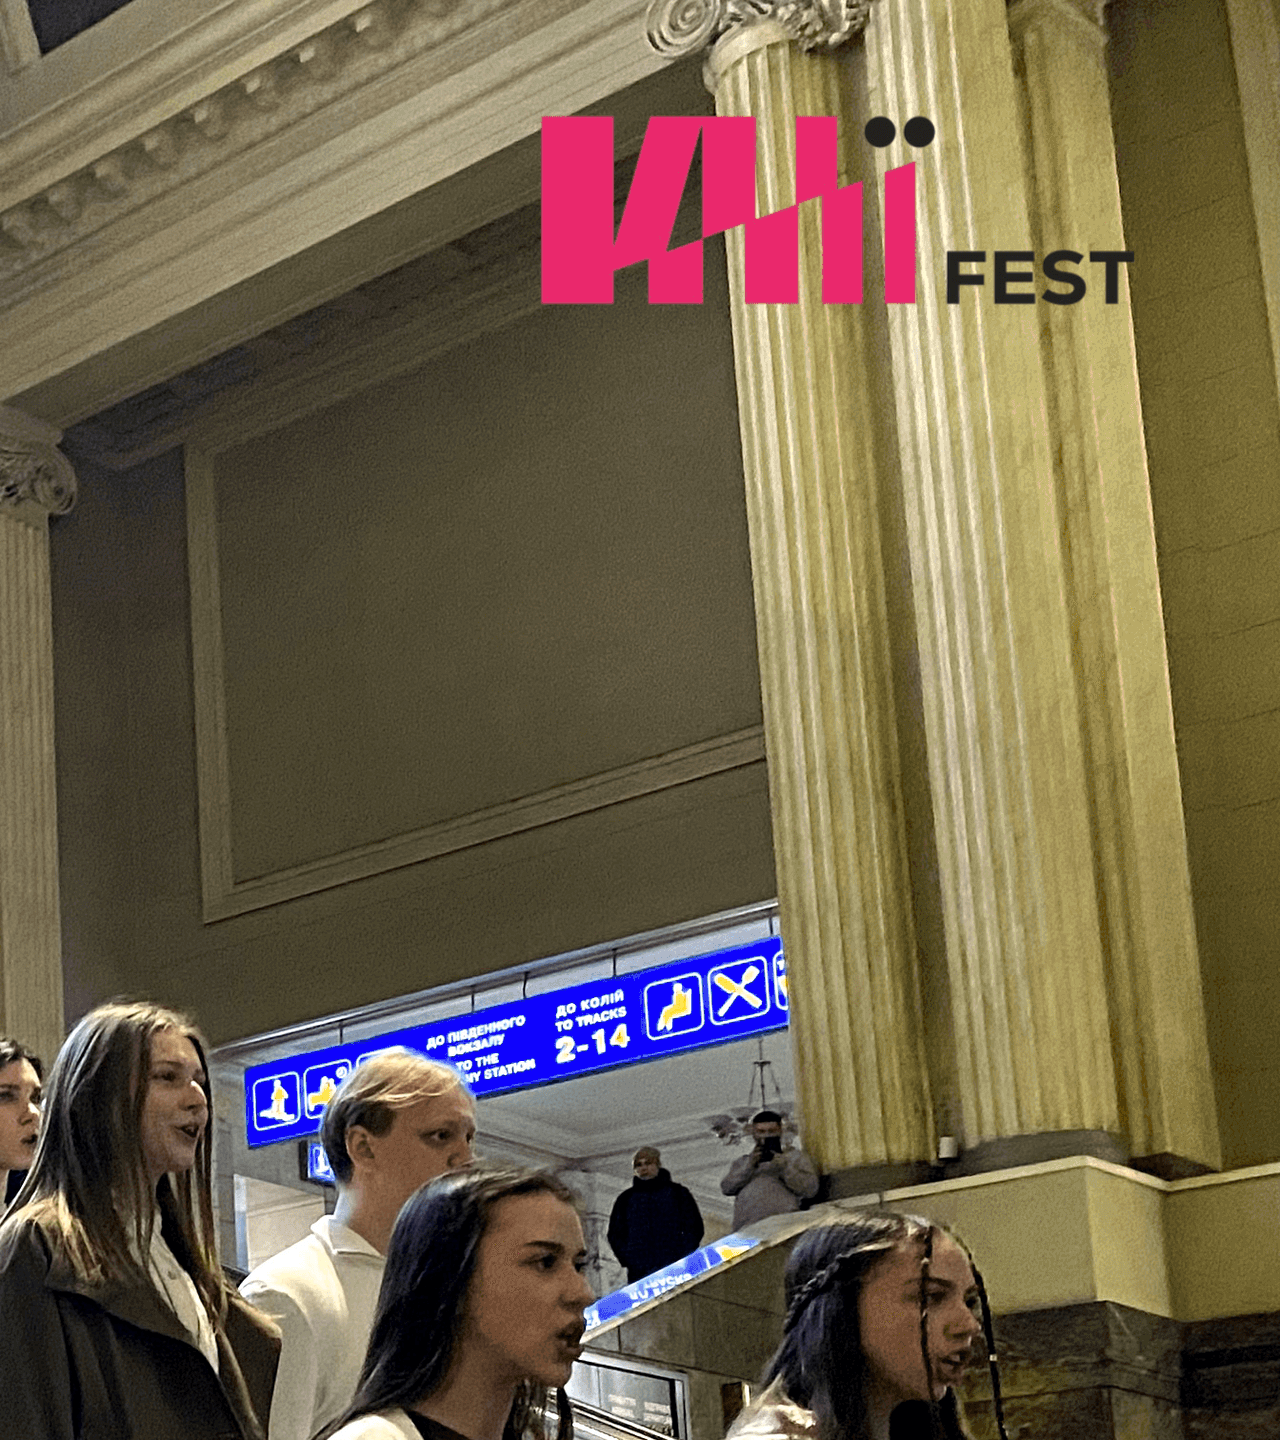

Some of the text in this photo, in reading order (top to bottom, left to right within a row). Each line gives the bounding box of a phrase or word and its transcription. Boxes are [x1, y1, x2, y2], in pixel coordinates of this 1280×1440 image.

[556, 988, 625, 1019] ДО КОЛІЙ
[555, 1006, 627, 1032] TO TRACKS
[426, 1015, 526, 1050] ДО ПІВДЕННОГО
[448, 1033, 505, 1057] ВОКЗАЛУ
[555, 1023, 631, 1064] 2-14
[475, 1053, 500, 1068] THE
[484, 1058, 536, 1080] STATION
